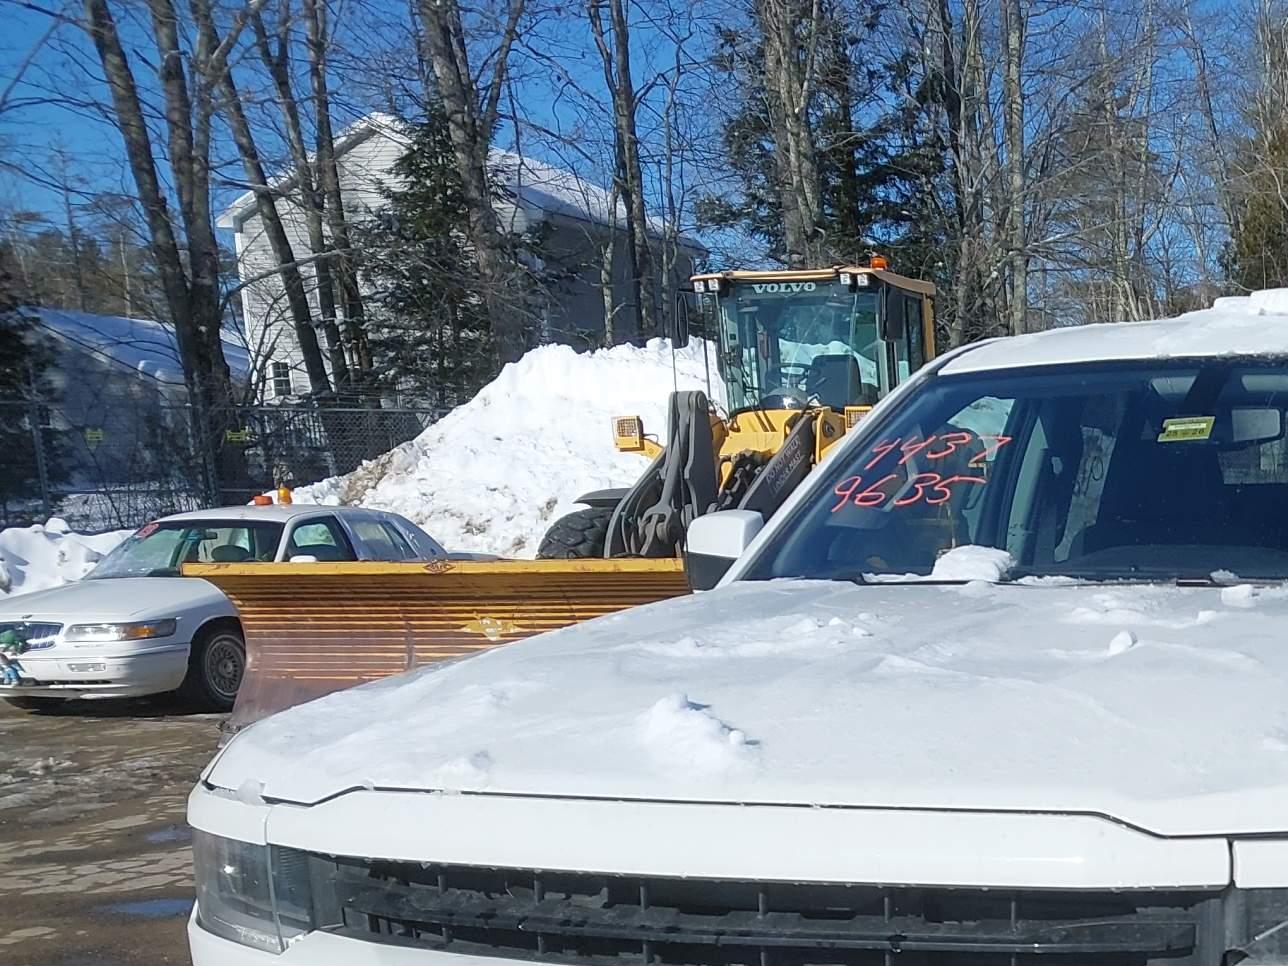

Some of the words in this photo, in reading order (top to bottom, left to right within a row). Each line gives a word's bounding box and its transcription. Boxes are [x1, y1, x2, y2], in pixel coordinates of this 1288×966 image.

[752, 282, 816, 294] VOLVO
[864, 432, 1012, 470] 4437
[831, 473, 986, 512] 9635
